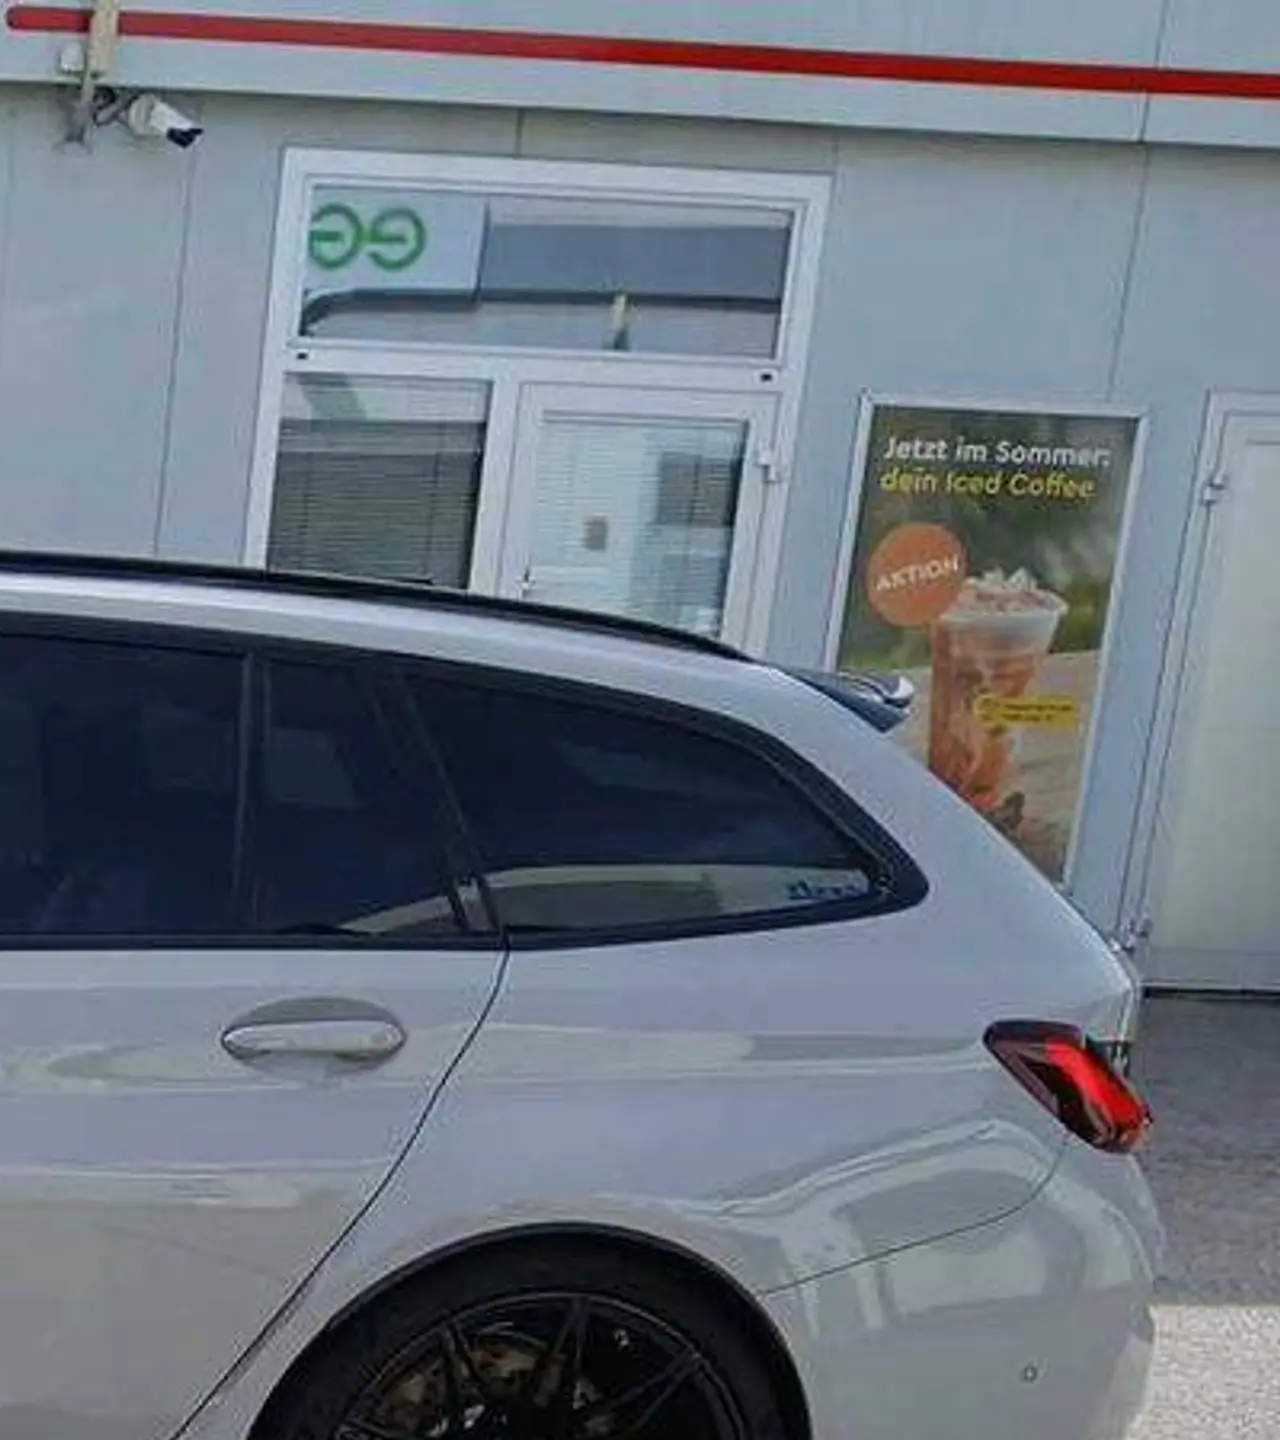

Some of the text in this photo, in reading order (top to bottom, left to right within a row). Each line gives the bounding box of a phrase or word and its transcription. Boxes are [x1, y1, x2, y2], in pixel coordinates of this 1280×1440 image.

[883, 436, 1111, 467] Jetzt im Sommer:
[880, 467, 1097, 499] dein Iced Coffee
[874, 554, 960, 592] AKTION
